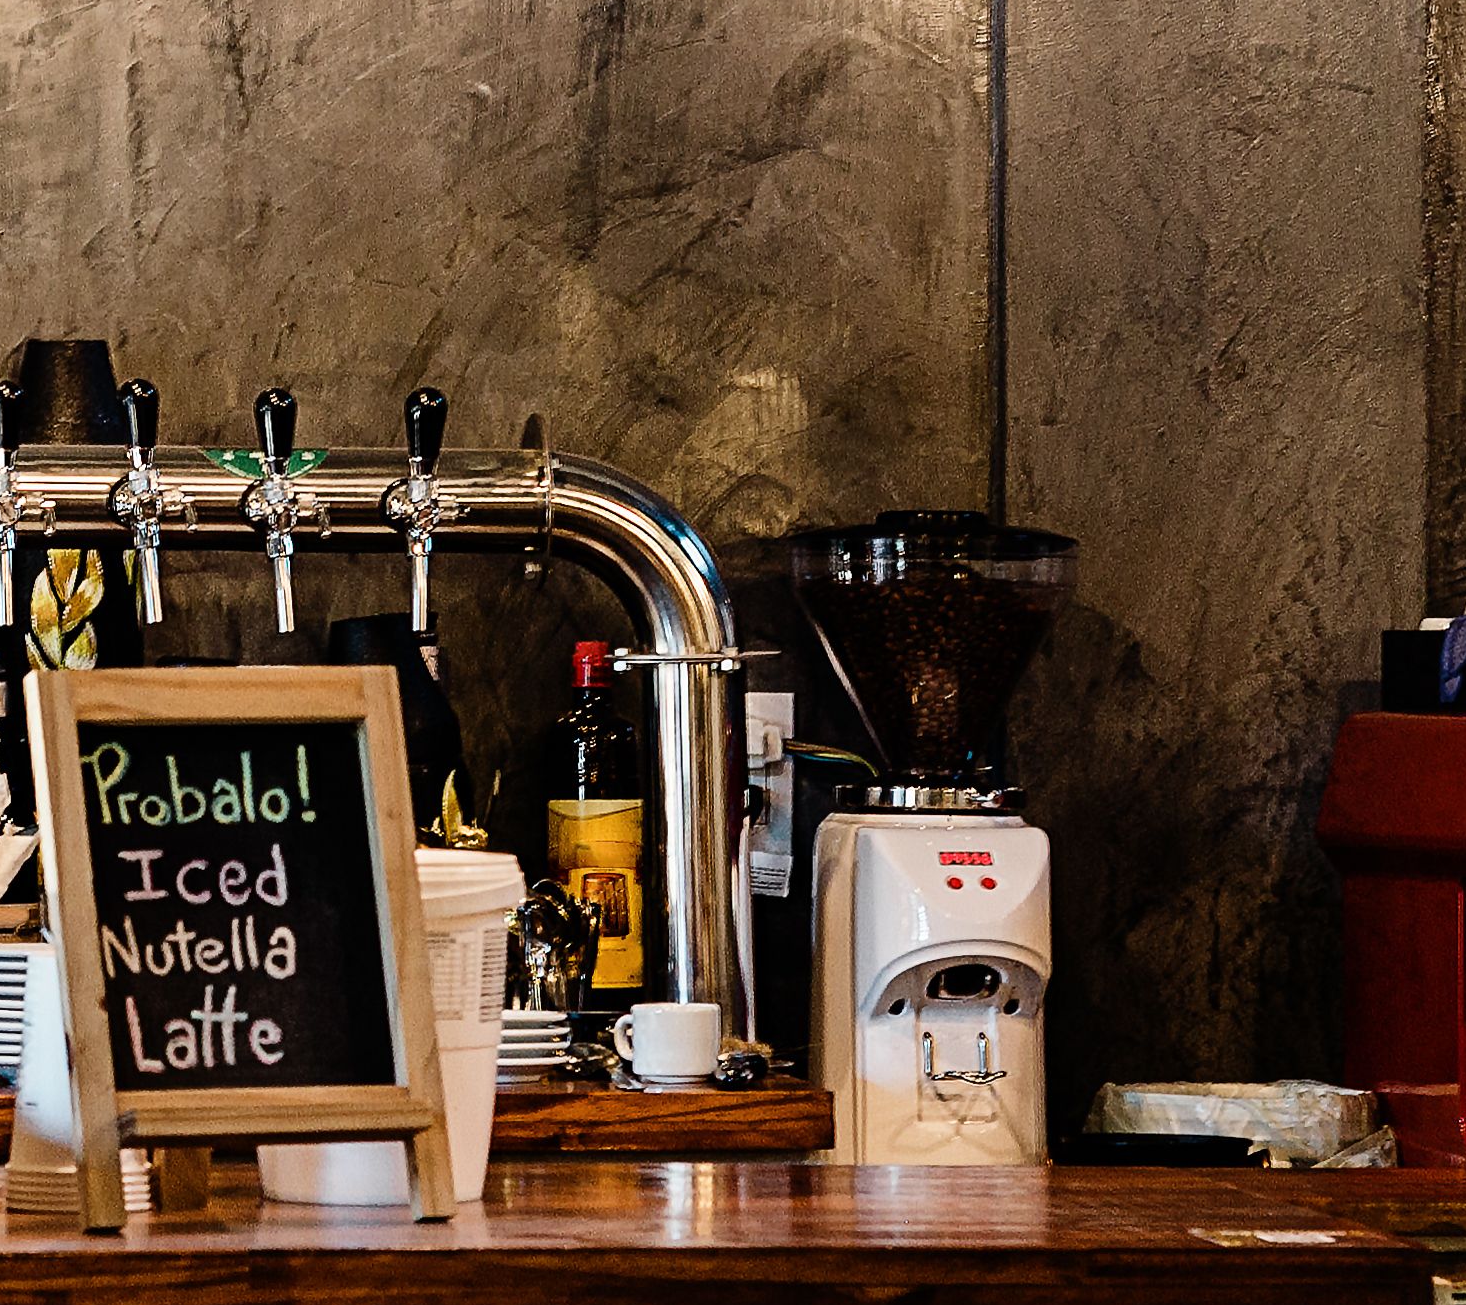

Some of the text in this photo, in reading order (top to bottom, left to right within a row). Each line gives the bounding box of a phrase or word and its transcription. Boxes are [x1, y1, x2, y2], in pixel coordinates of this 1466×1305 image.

[81, 742, 317, 826] Probalo!
[117, 843, 289, 907] Iced
[99, 914, 298, 980] Nutella
[125, 984, 285, 1074] Latte
